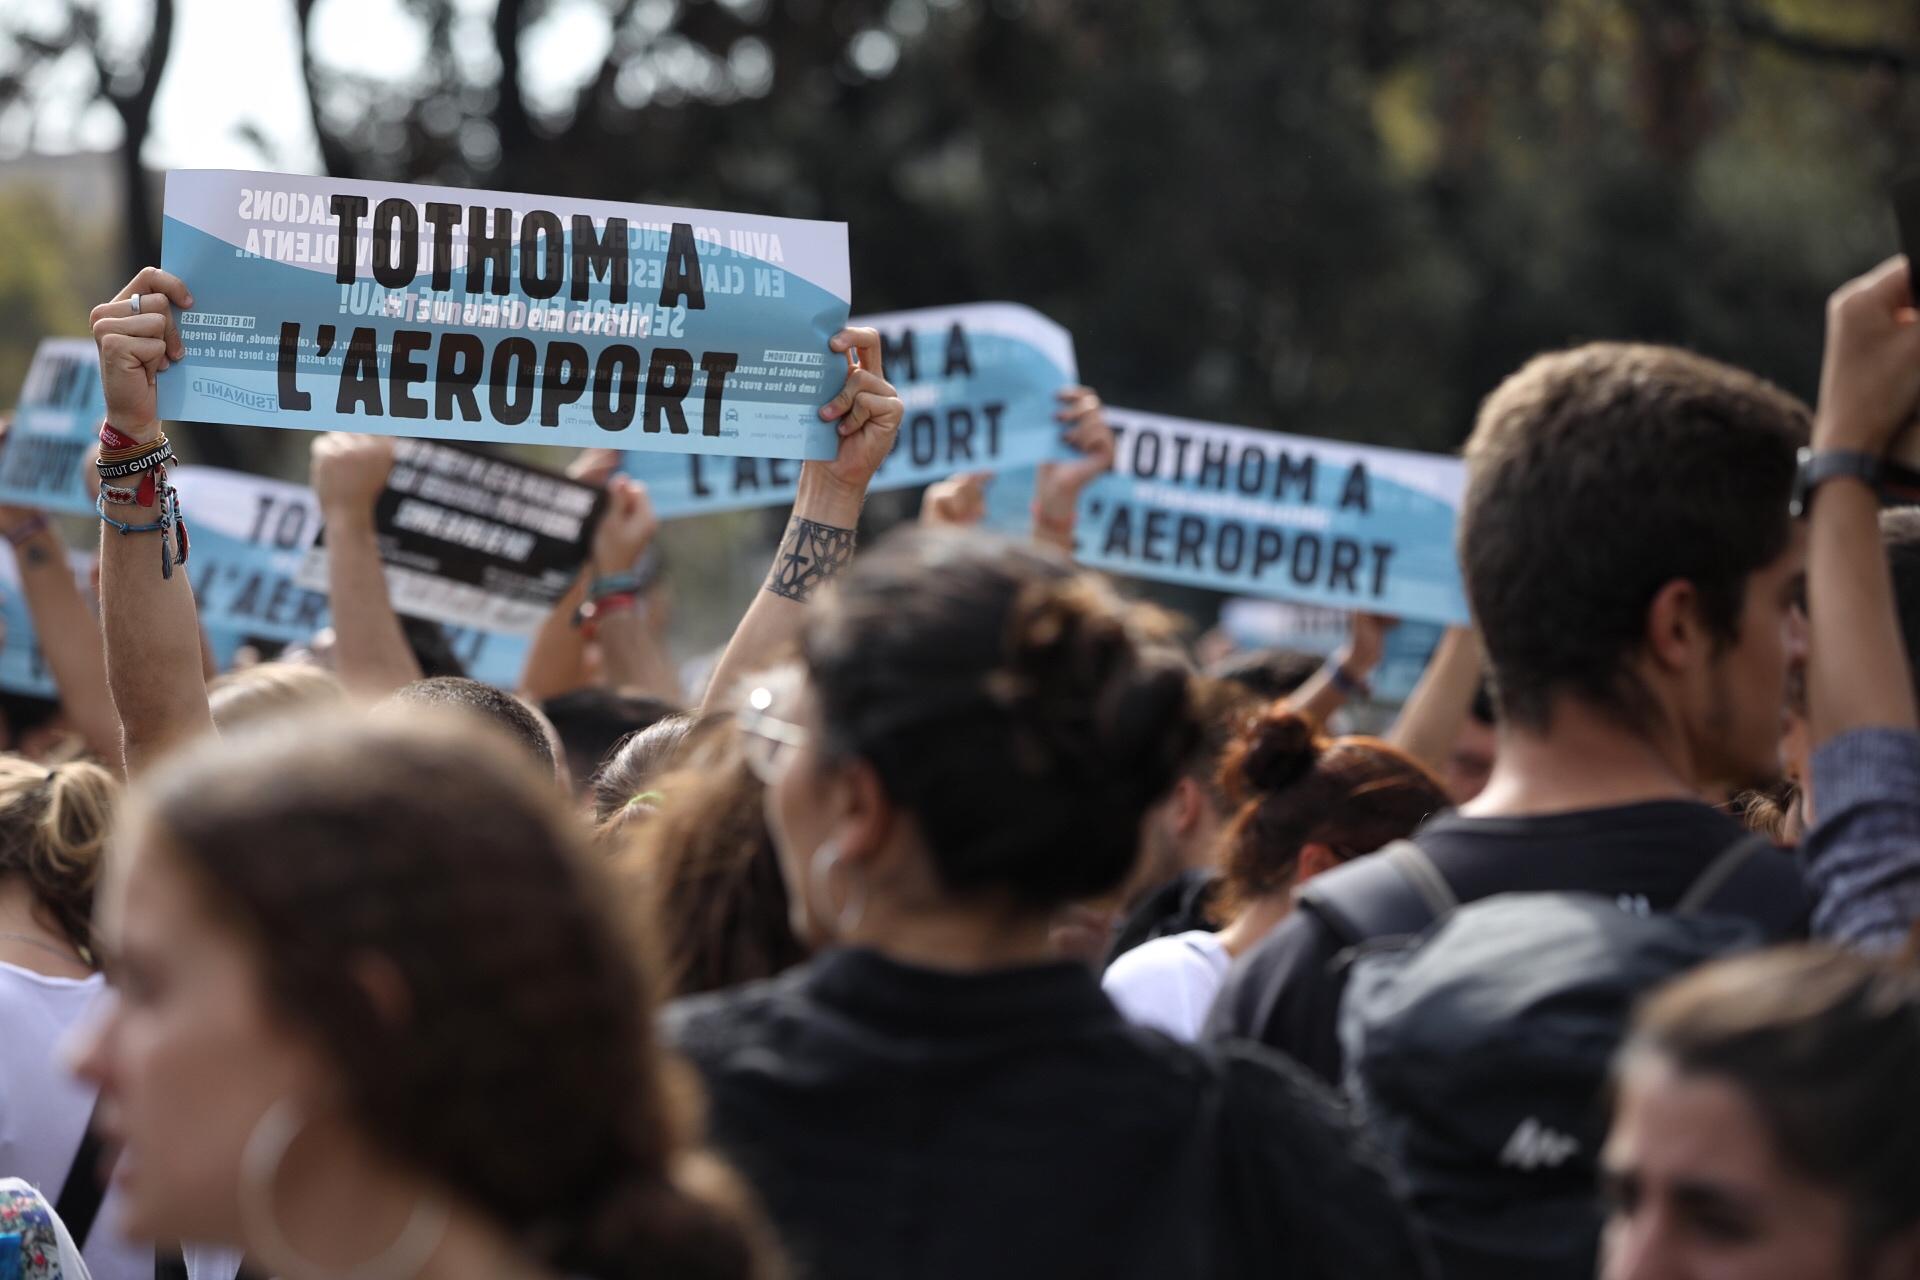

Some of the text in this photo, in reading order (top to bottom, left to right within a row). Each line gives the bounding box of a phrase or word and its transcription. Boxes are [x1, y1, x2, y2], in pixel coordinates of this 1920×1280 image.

[330, 194, 706, 310] TOTHOM A
[278, 321, 738, 437] L'AEROPORT
[1339, 460, 1371, 514] A
[1077, 502, 1397, 597] 'AEROPORT
